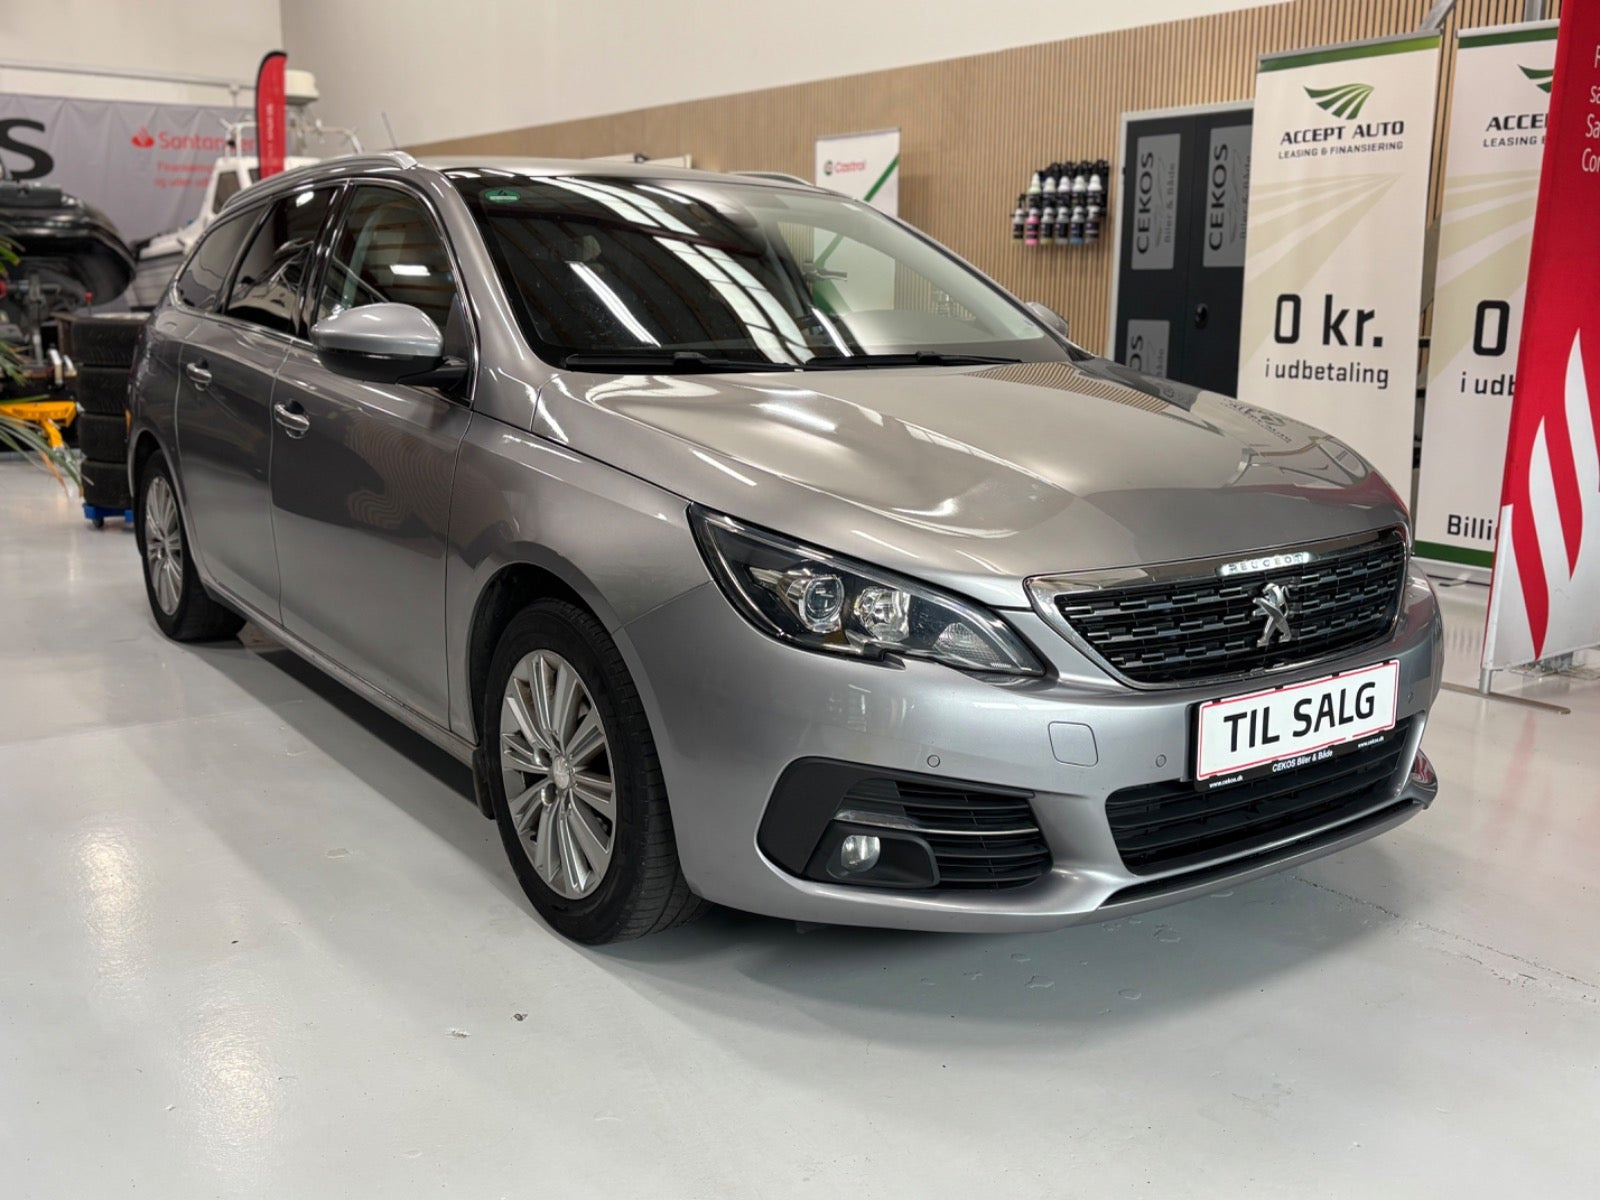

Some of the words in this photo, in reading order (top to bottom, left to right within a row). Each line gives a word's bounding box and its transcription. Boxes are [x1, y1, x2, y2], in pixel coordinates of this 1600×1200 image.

[158, 130, 255, 153] Santaner
[1280, 125, 1346, 146] ACCEPT
[1352, 120, 1405, 139] AUTO
[1483, 135, 1538, 148] LEASING
[1278, 147, 1318, 160] LEASING
[1320, 147, 1327, 156] &
[1329, 140, 1404, 155] FINANSIERING
[1136, 152, 1154, 254] CEKOS
[1209, 143, 1229, 251] CEKOS
[1322, 293, 1384, 348] kr.
[1265, 358, 1270, 378] i
[1275, 359, 1389, 390] udbetaling
[1461, 371, 1467, 393] i
[1447, 513, 1497, 541] Billi
[1223, 705, 1280, 753] TIL
[1292, 681, 1376, 739] SALG
[1272, 758, 1296, 773] CEKOS
